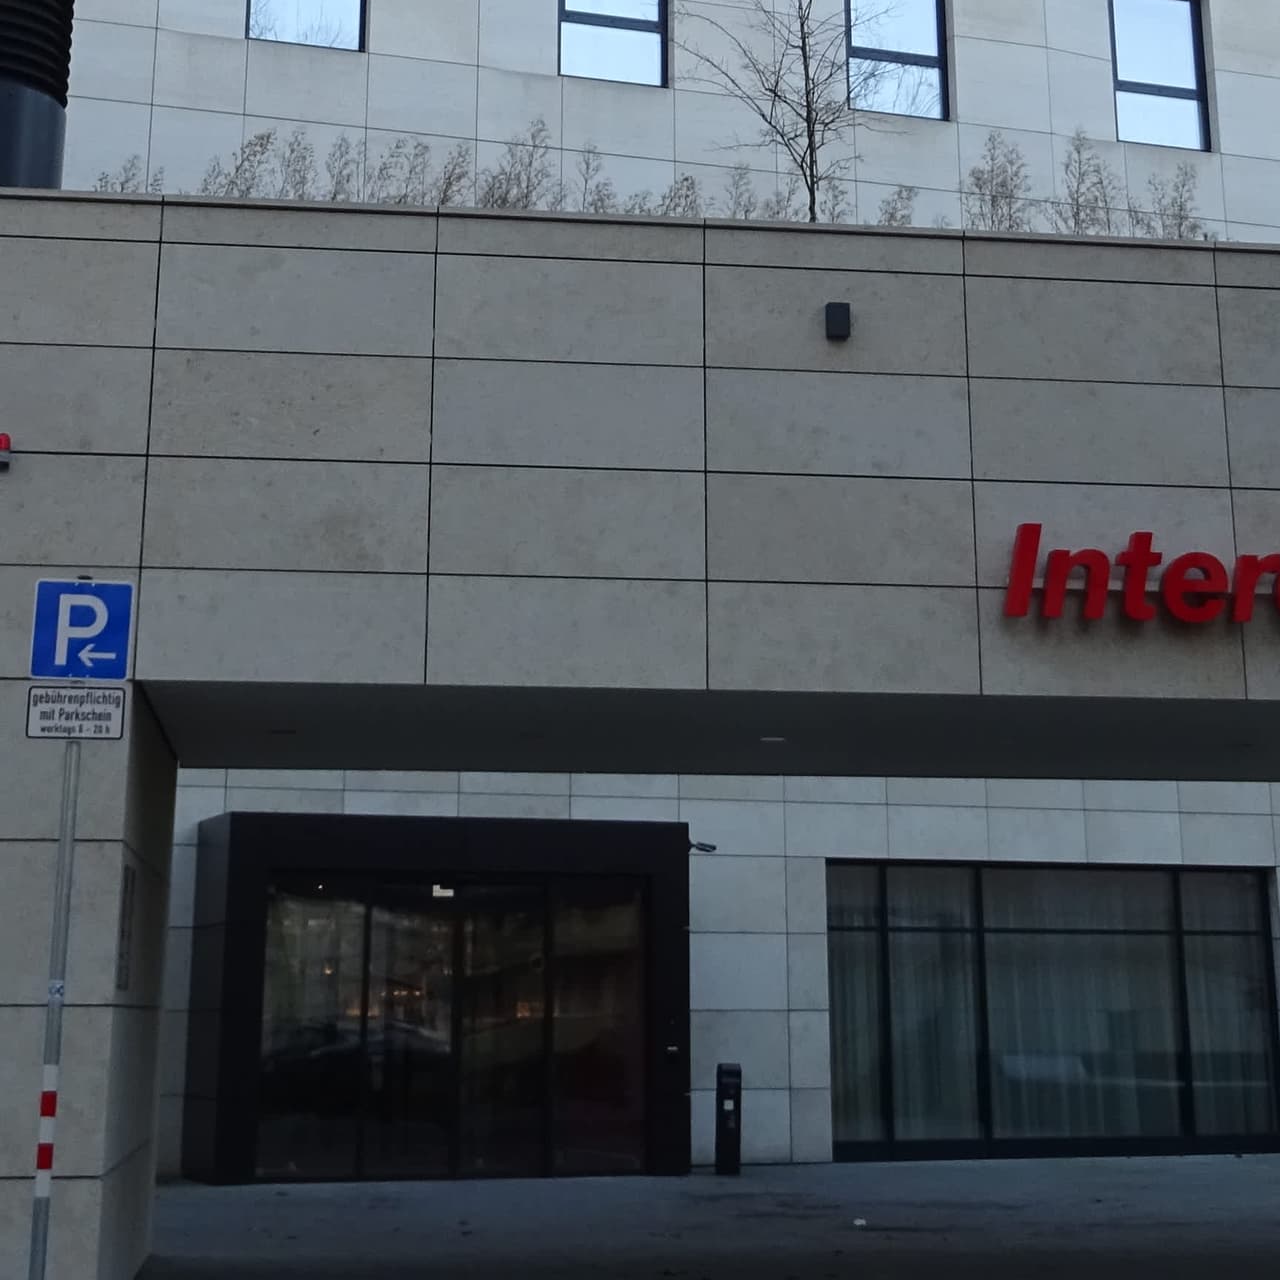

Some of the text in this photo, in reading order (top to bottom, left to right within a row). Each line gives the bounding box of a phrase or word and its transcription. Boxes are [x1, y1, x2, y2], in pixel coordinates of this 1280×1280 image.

[54, 593, 109, 666] P
[32, 690, 121, 708] gebührenpflichtig
[39, 708, 112, 722] mit Parkschein
